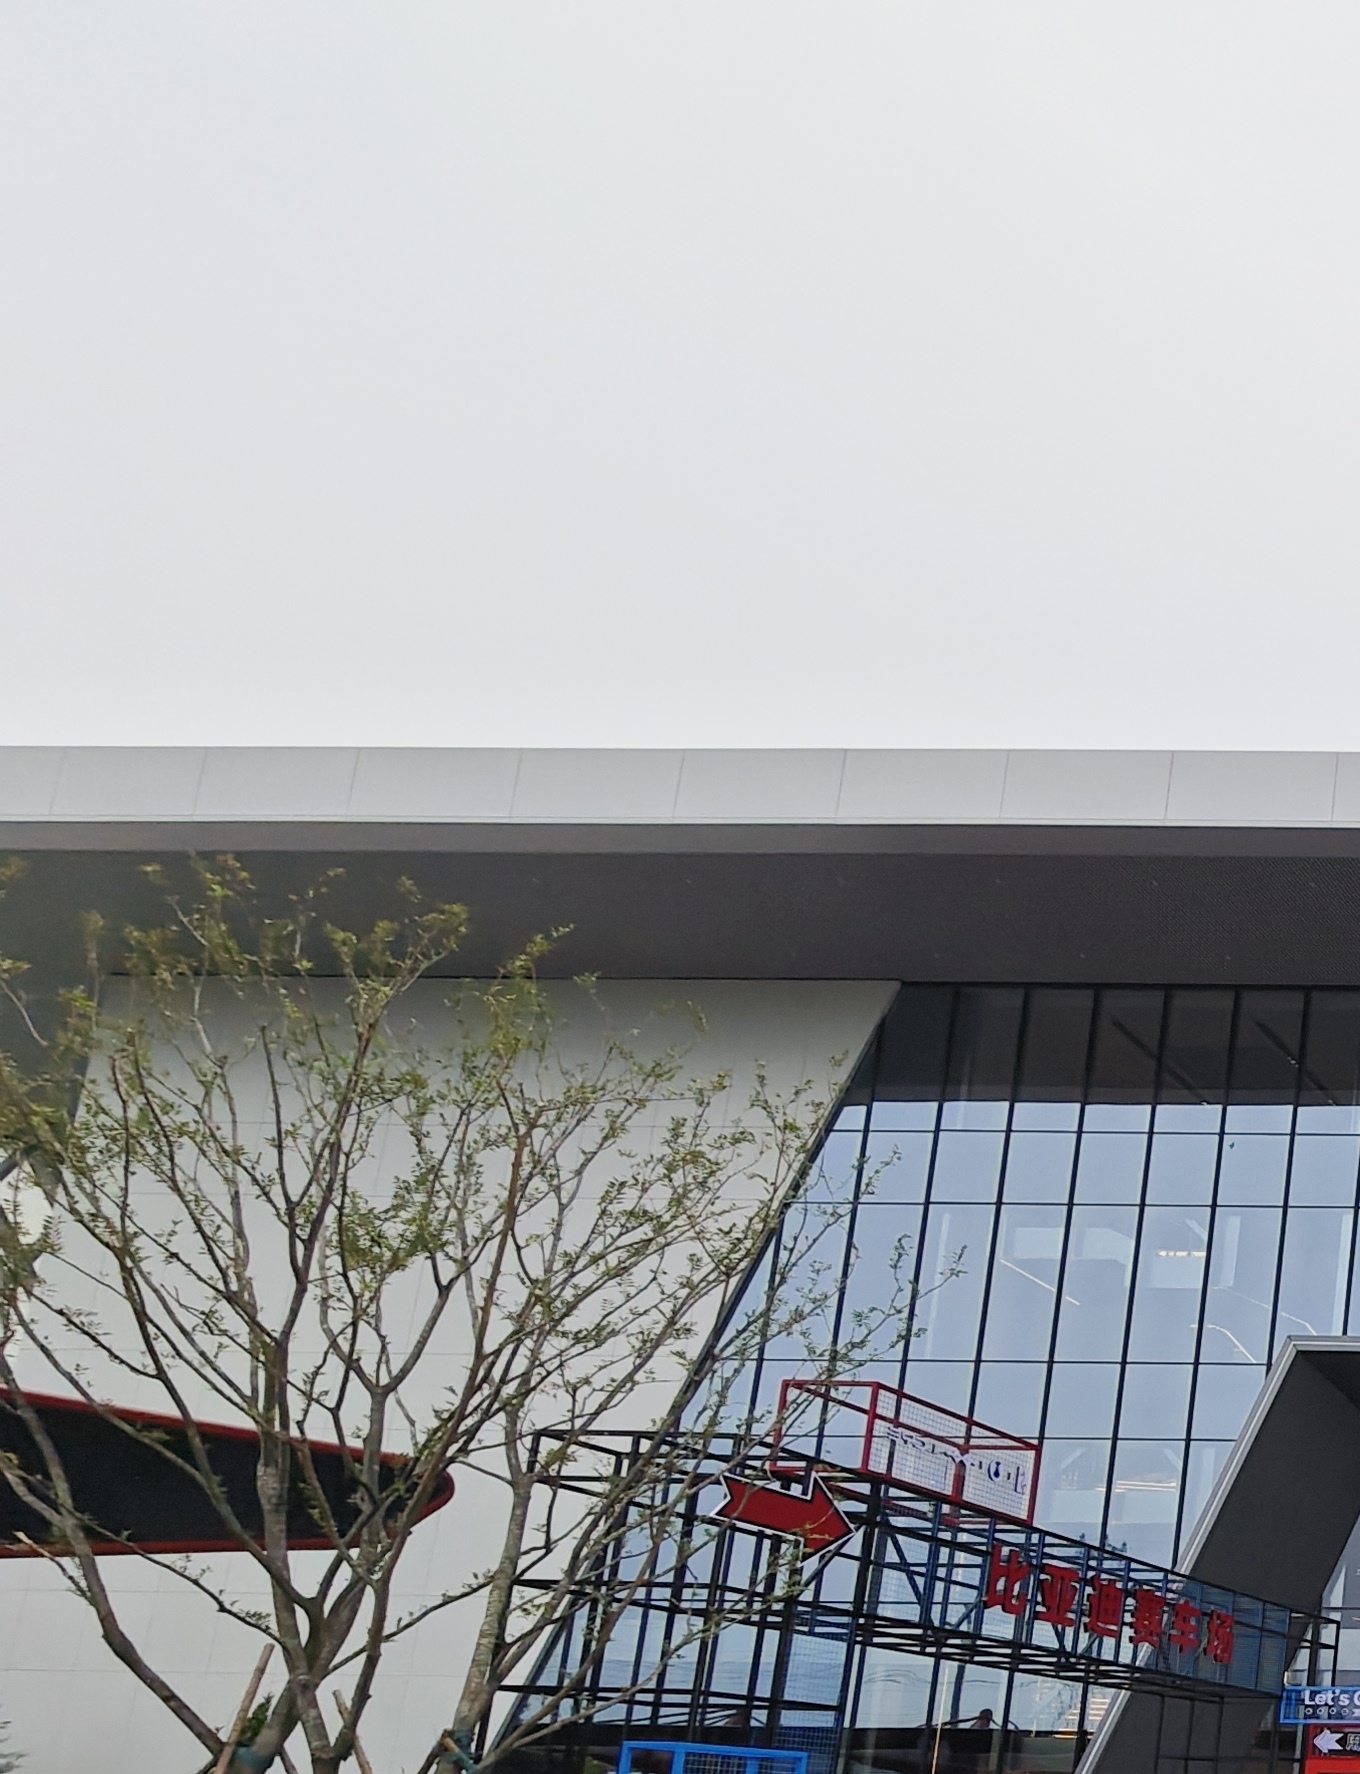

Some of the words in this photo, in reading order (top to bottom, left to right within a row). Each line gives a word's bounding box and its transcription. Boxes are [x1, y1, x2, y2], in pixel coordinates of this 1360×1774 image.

[984, 1541, 1235, 1665] 比亚迪赛车场
[1304, 1689, 1350, 1706] Let's
